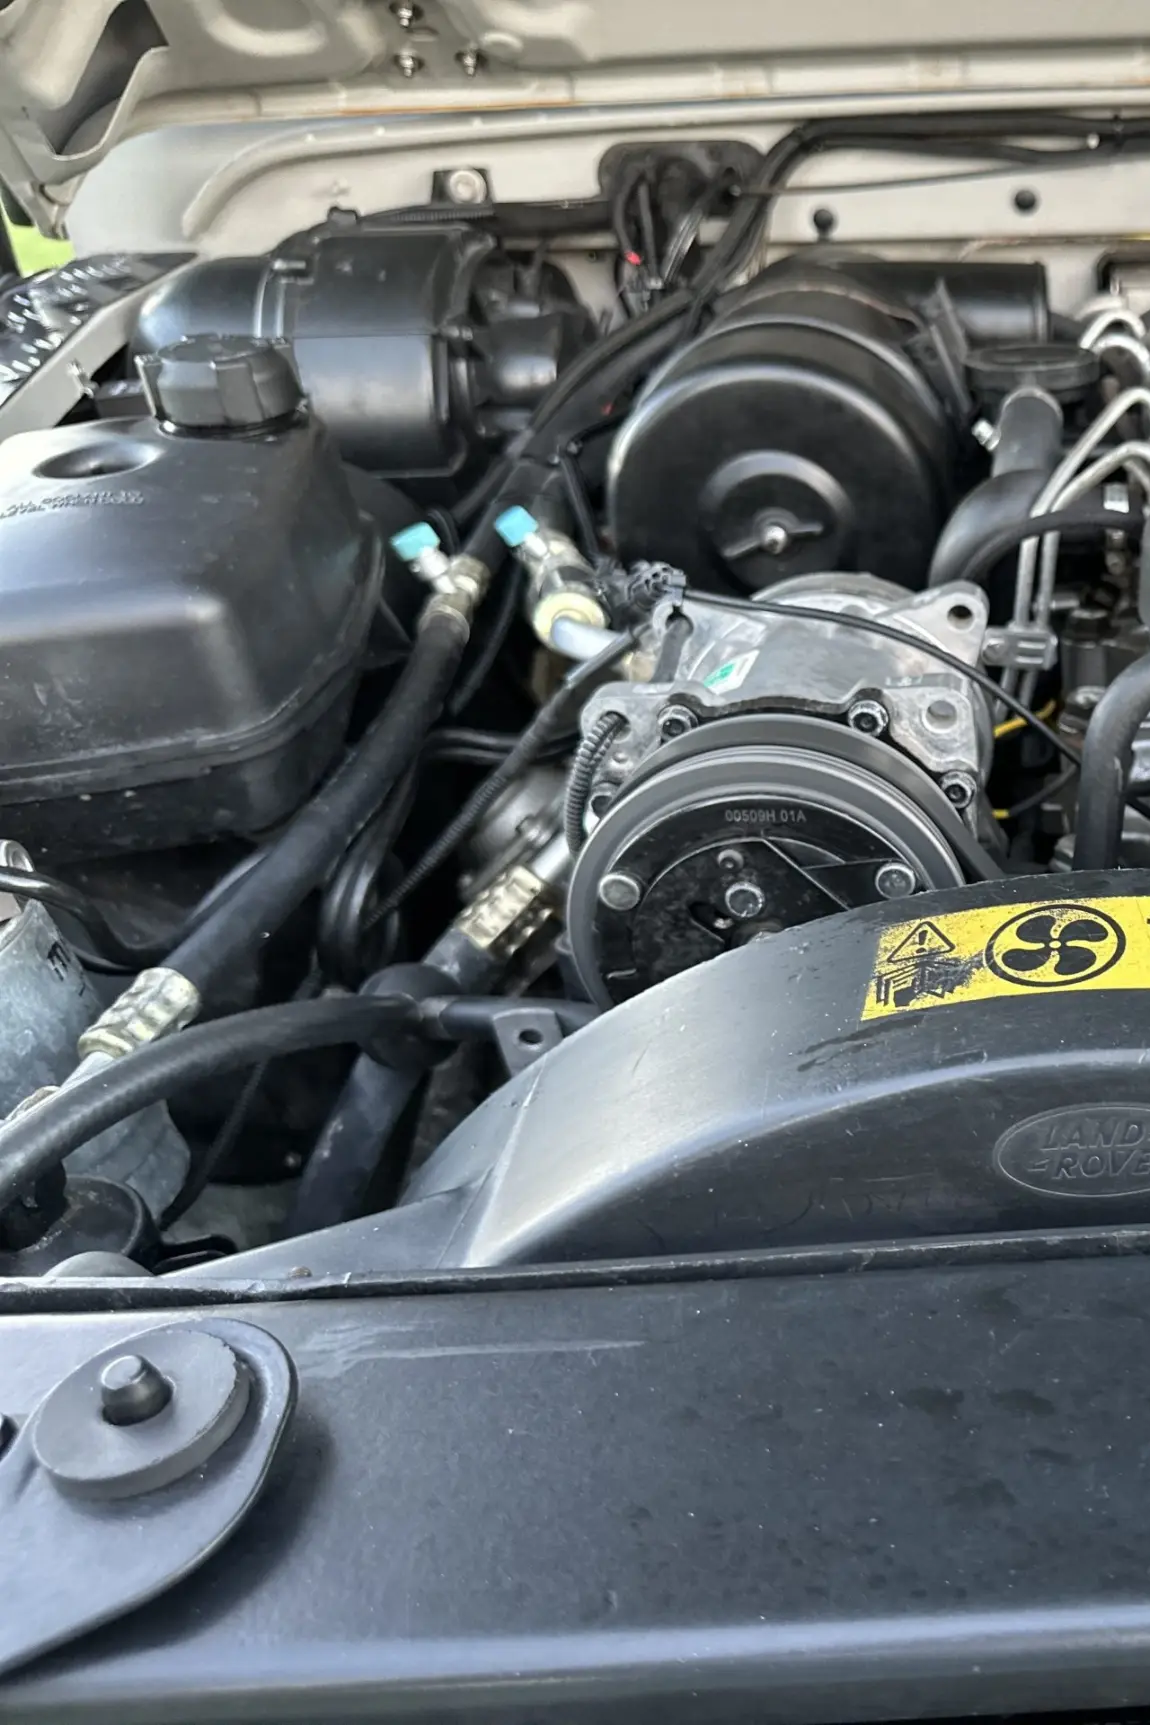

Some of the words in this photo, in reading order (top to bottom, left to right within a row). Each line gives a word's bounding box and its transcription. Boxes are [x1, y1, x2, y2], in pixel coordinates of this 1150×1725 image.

[725, 808, 777, 823] 00509H
[780, 808, 808, 823] 01A
[1039, 1119, 1147, 1152] LAND
